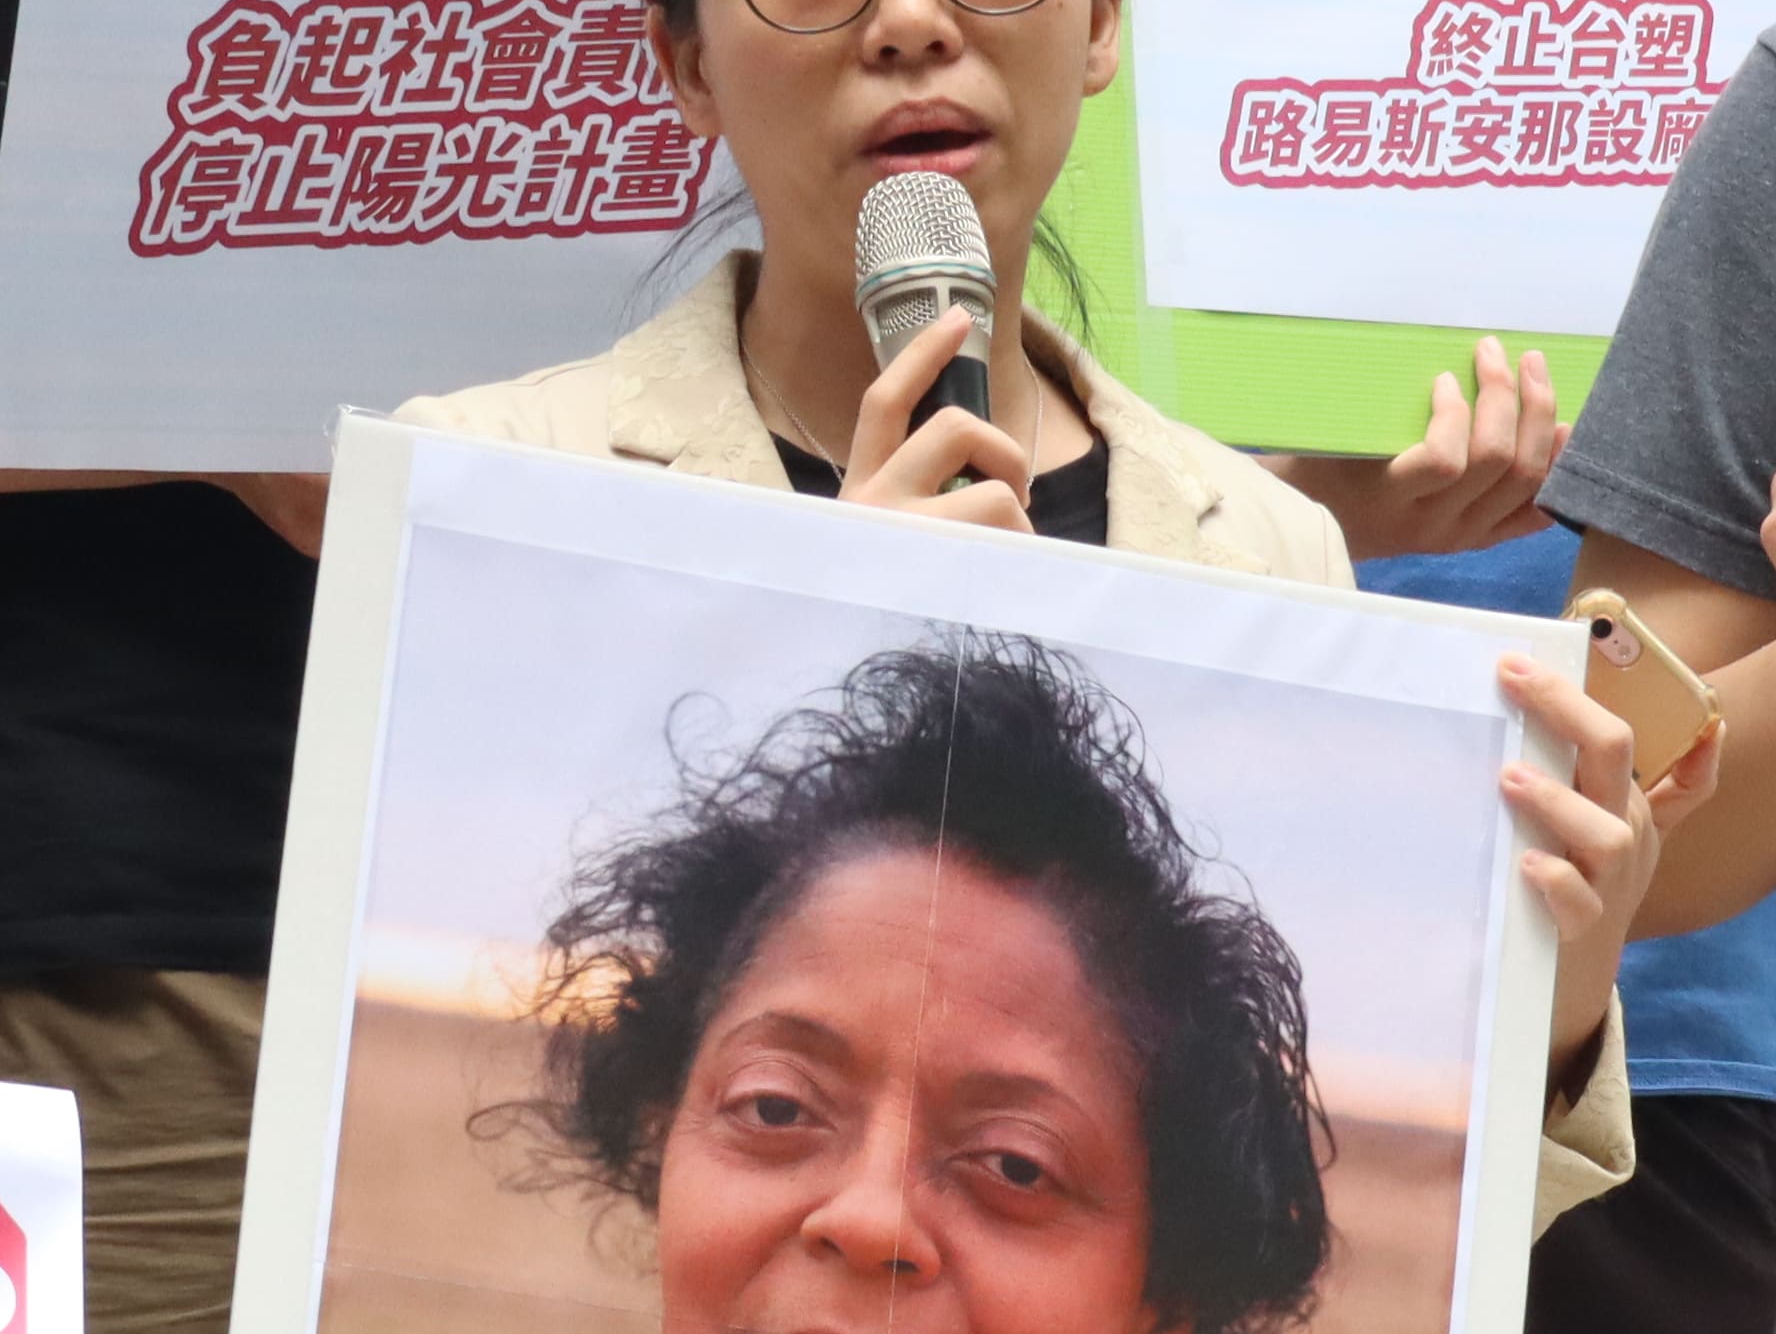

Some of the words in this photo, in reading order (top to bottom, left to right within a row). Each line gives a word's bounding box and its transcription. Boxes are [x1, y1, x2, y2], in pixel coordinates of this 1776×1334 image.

[1422, 4, 1698, 83] 終止台塑
[146, 107, 694, 244] 停止陽光計畫
